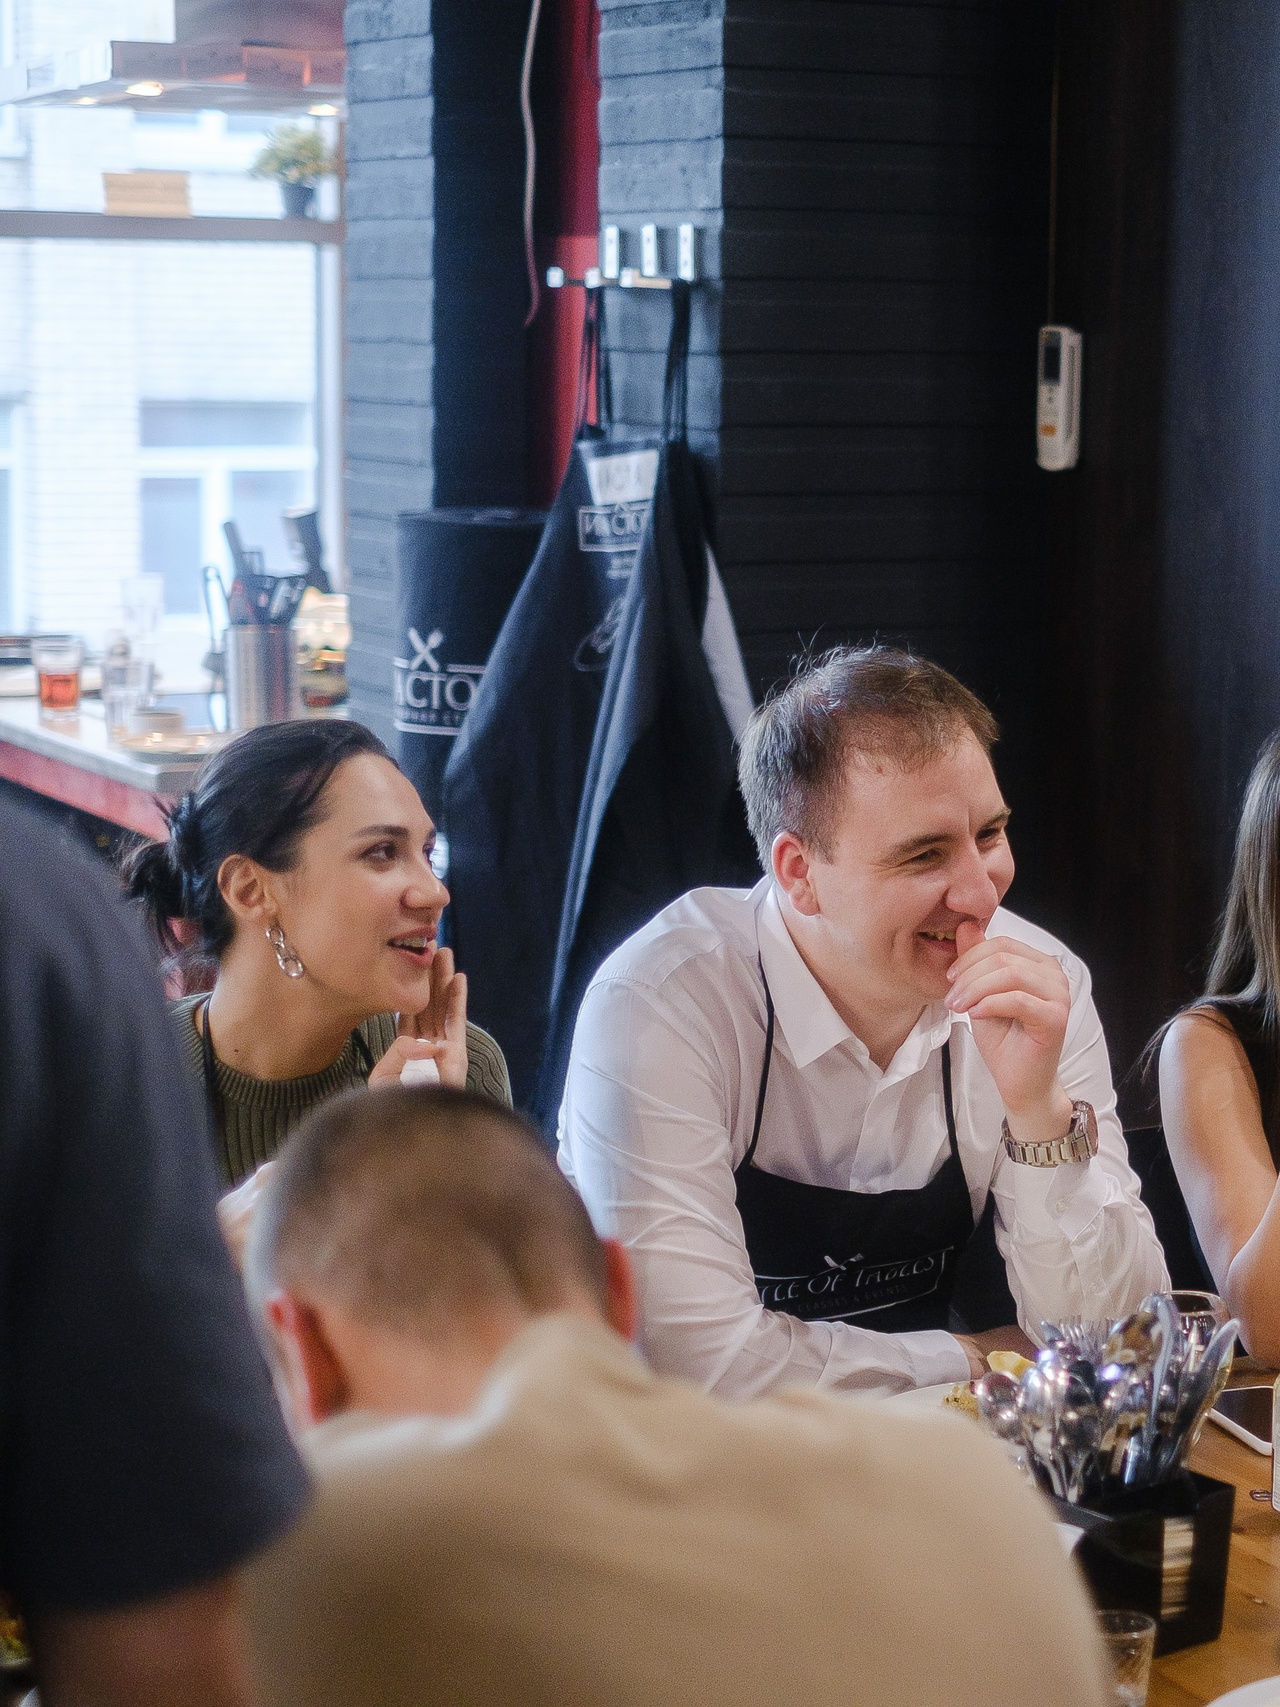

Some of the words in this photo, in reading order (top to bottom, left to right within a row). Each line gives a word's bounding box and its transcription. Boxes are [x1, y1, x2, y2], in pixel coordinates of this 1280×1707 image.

[758, 1281, 800, 1304] TLE
[807, 1274, 847, 1293] OF
[797, 1295, 848, 1313] CLASSES
